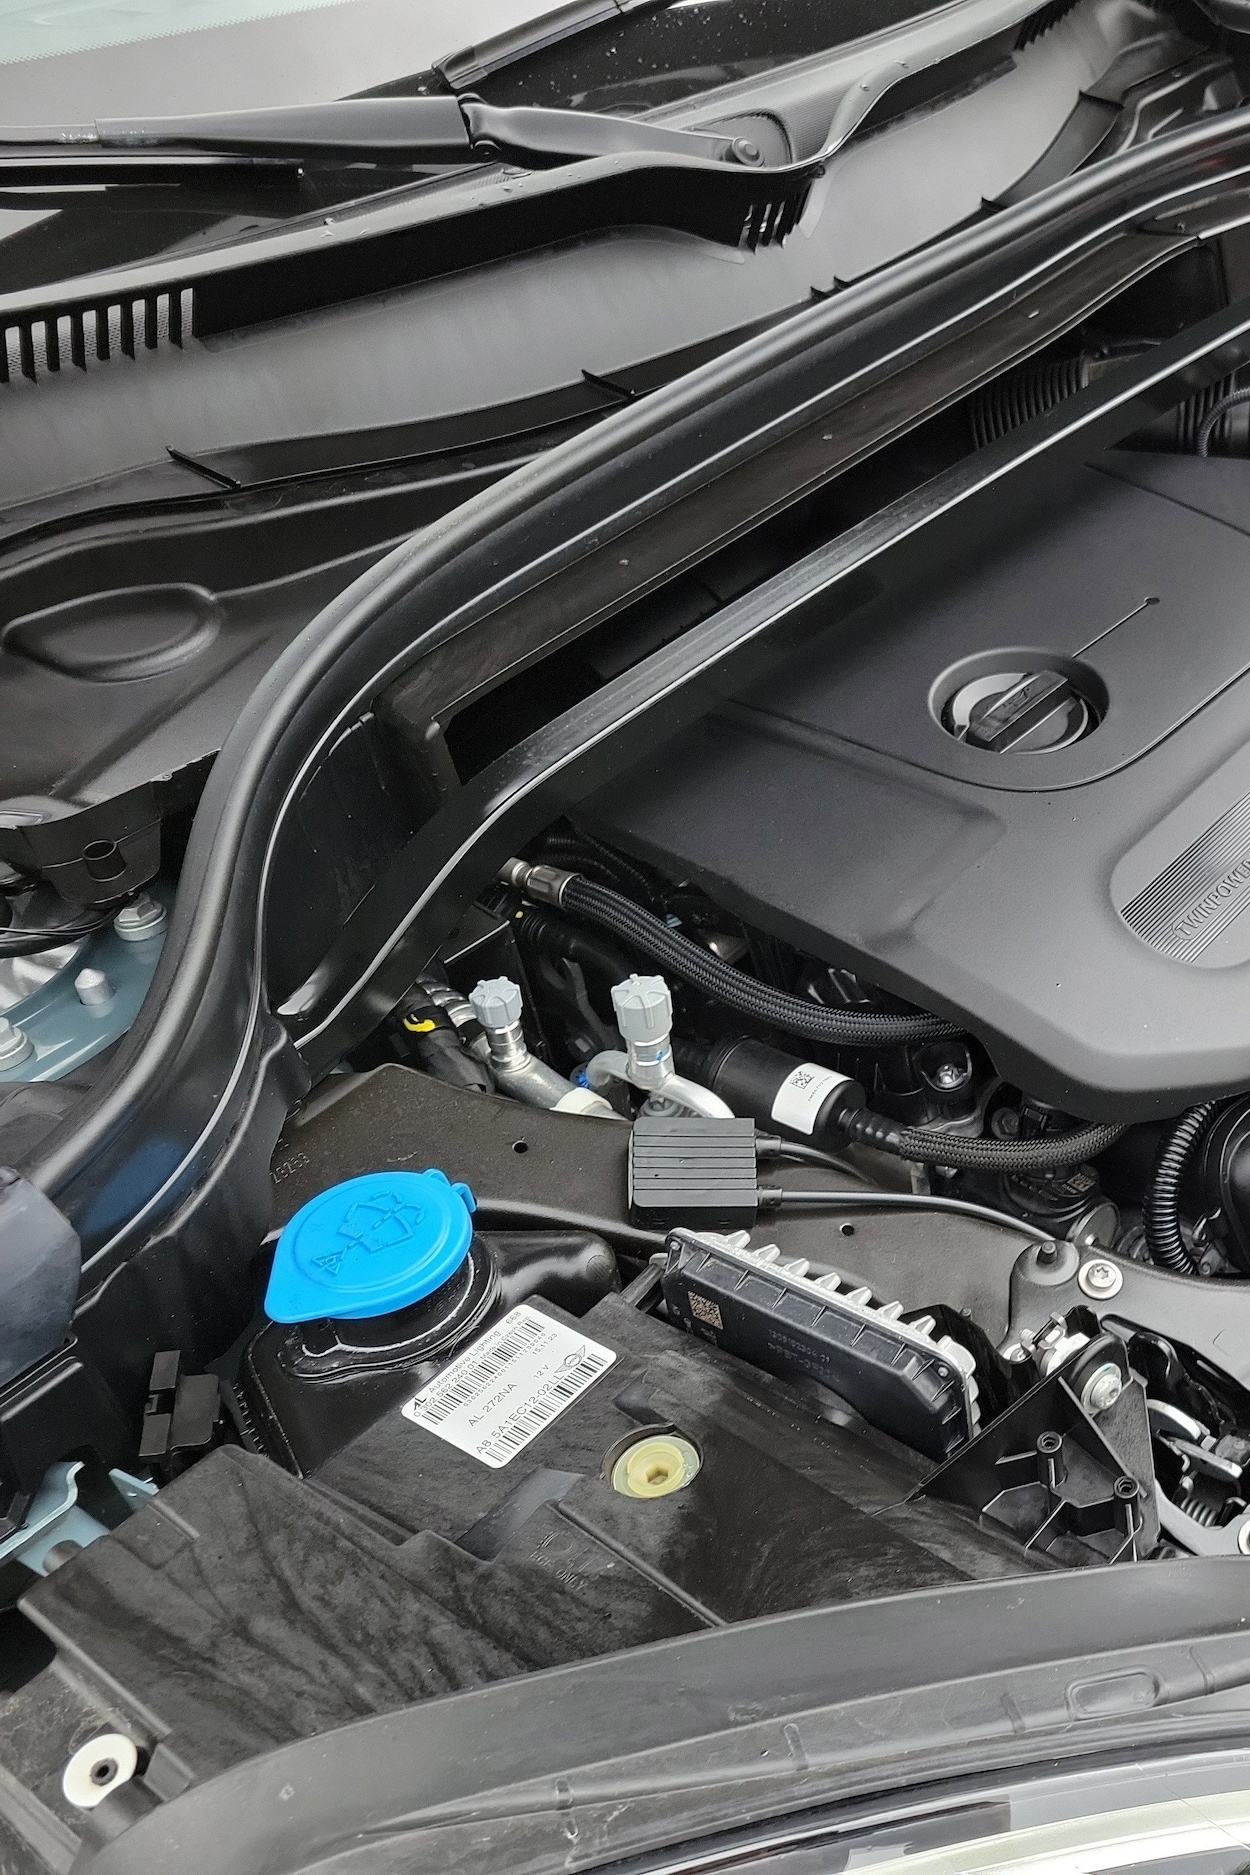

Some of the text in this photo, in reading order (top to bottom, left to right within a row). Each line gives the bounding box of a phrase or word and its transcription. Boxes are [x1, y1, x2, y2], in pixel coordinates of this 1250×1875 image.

[428, 1354, 472, 1394] Automotive
[470, 1330, 502, 1361] Lighting
[505, 1311, 522, 1325] 668
[532, 1333, 558, 1355] 15.11.23
[420, 1397, 437, 1411] 302
[436, 1383, 453, 1398] 562
[452, 1370, 468, 1384] 240
[466, 1360, 479, 1371] 01
[533, 1370, 543, 1379] 12
[468, 1383, 518, 1427] AL 272NA
[475, 1439, 492, 1454] A8
